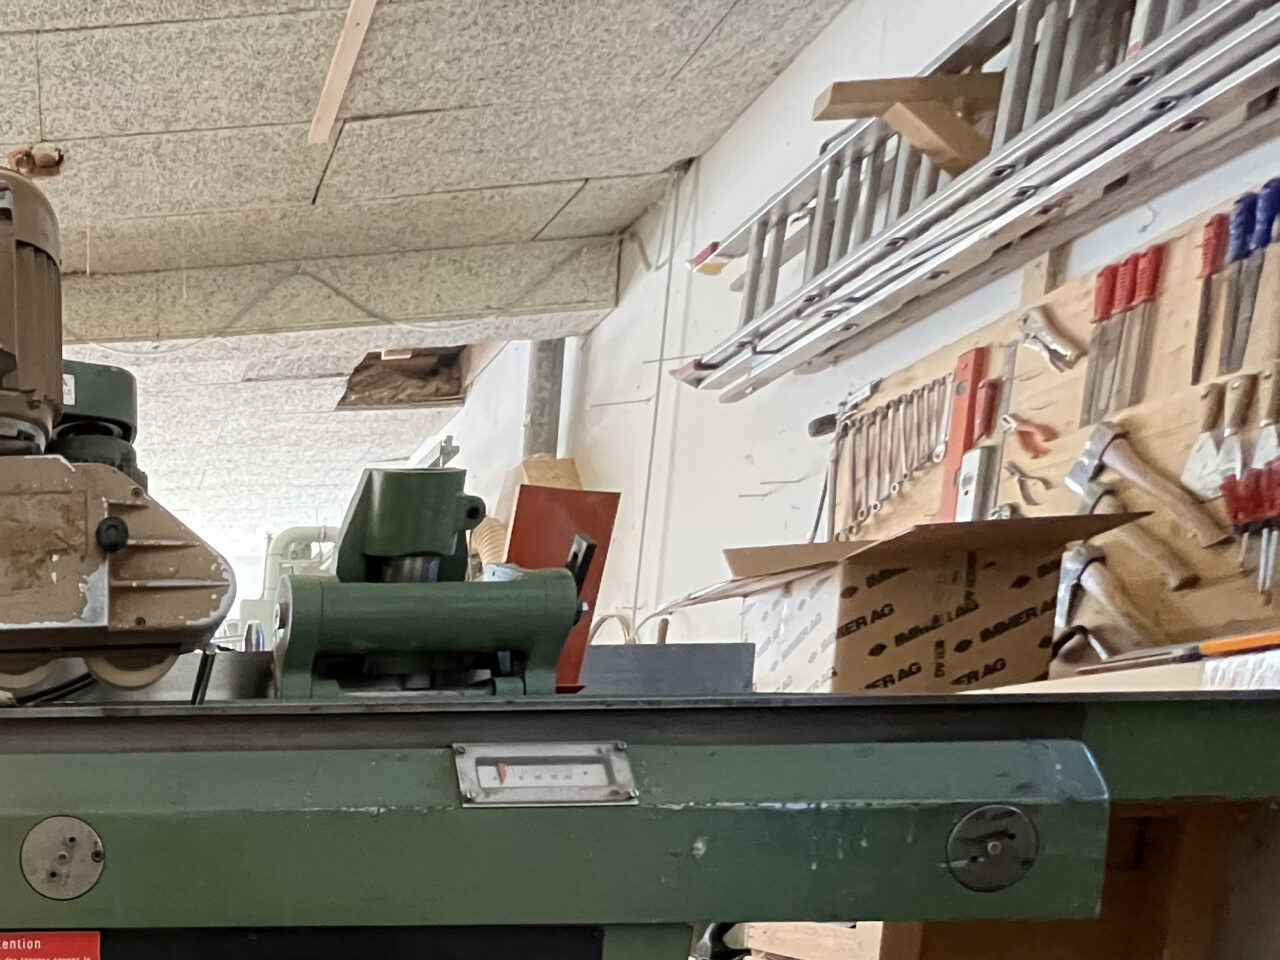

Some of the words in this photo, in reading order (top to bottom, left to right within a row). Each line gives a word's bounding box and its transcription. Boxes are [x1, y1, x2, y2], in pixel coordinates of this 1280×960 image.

[870, 603, 895, 624] AG
[979, 606, 1038, 643] IMMER
[897, 661, 922, 682] AG
[981, 657, 1007, 679] AG
